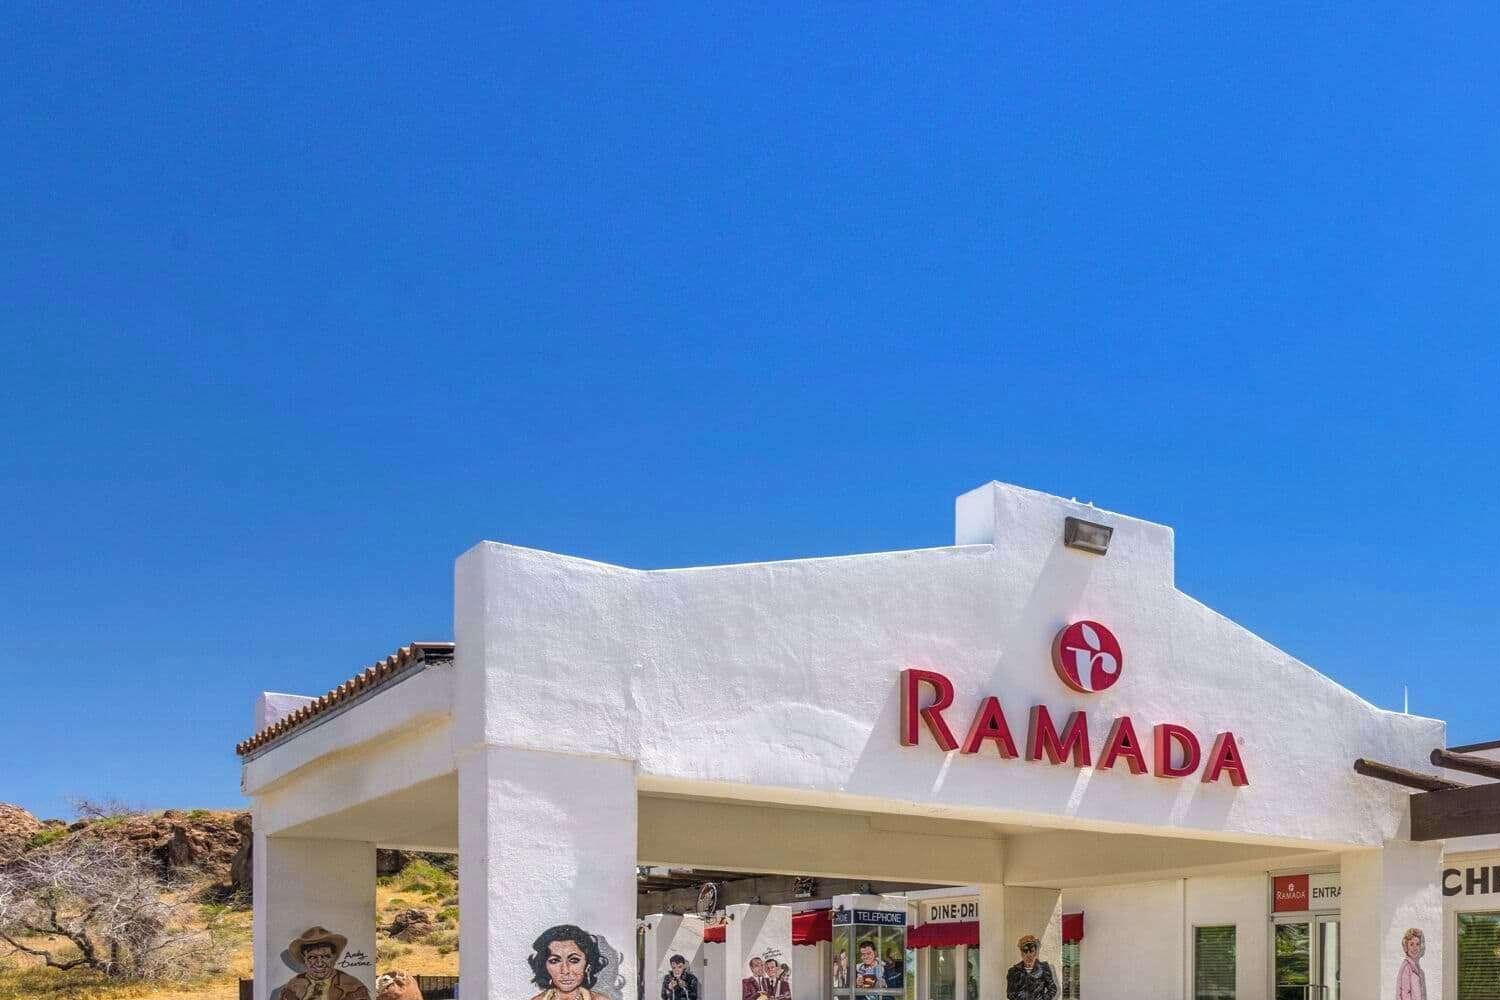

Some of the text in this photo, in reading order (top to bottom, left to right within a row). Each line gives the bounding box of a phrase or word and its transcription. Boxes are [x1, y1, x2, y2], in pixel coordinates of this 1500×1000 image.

[899, 668, 1249, 787] RAMADA
[1276, 891, 1306, 900] RAMADA
[857, 911, 902, 923] TELEPHONE
